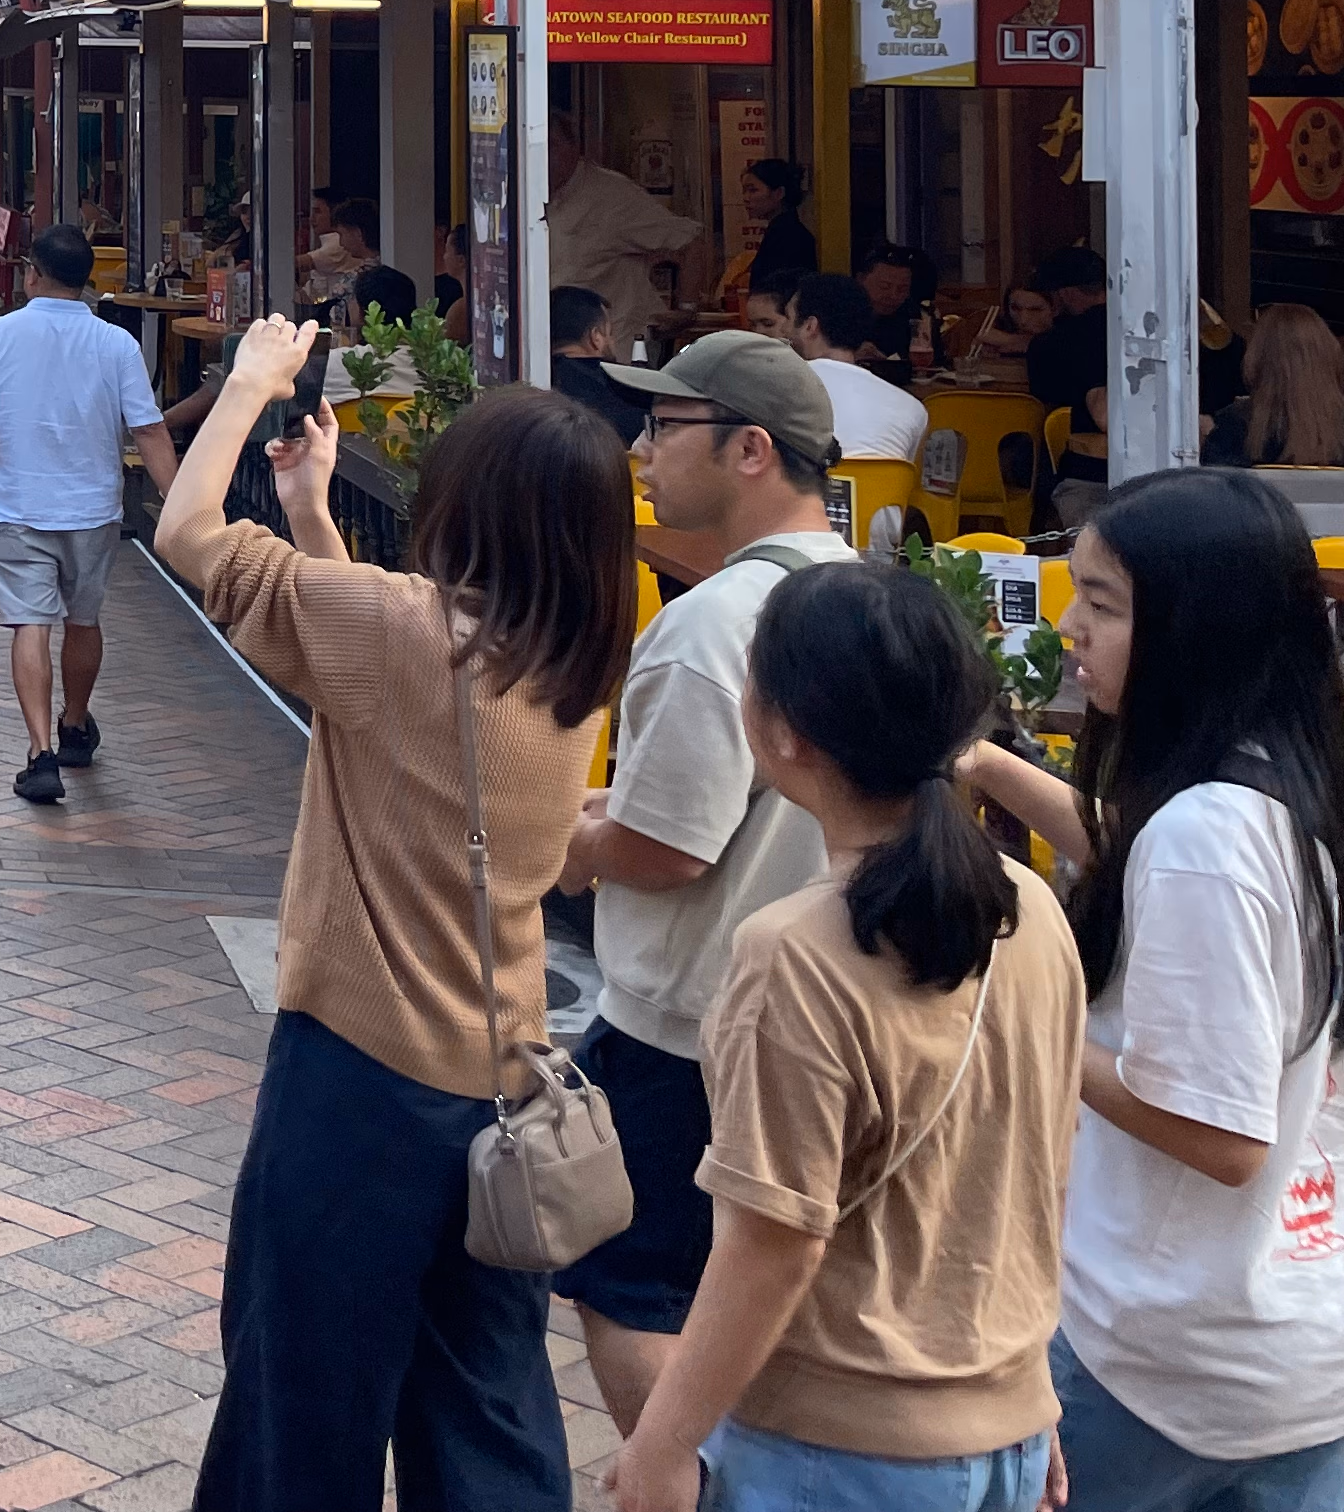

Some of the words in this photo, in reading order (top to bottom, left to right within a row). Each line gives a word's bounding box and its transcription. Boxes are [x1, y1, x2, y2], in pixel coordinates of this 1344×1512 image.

[606, 12, 673, 24] SEAFOOD
[676, 12, 770, 25] RESTAURANT
[548, 31, 573, 44] The
[576, 31, 621, 44] Yellow
[624, 32, 662, 44] Chair
[665, 32, 747, 47] Restaurant)
[1004, 30, 1080, 61] LEO
[878, 42, 949, 56] SINGHA
